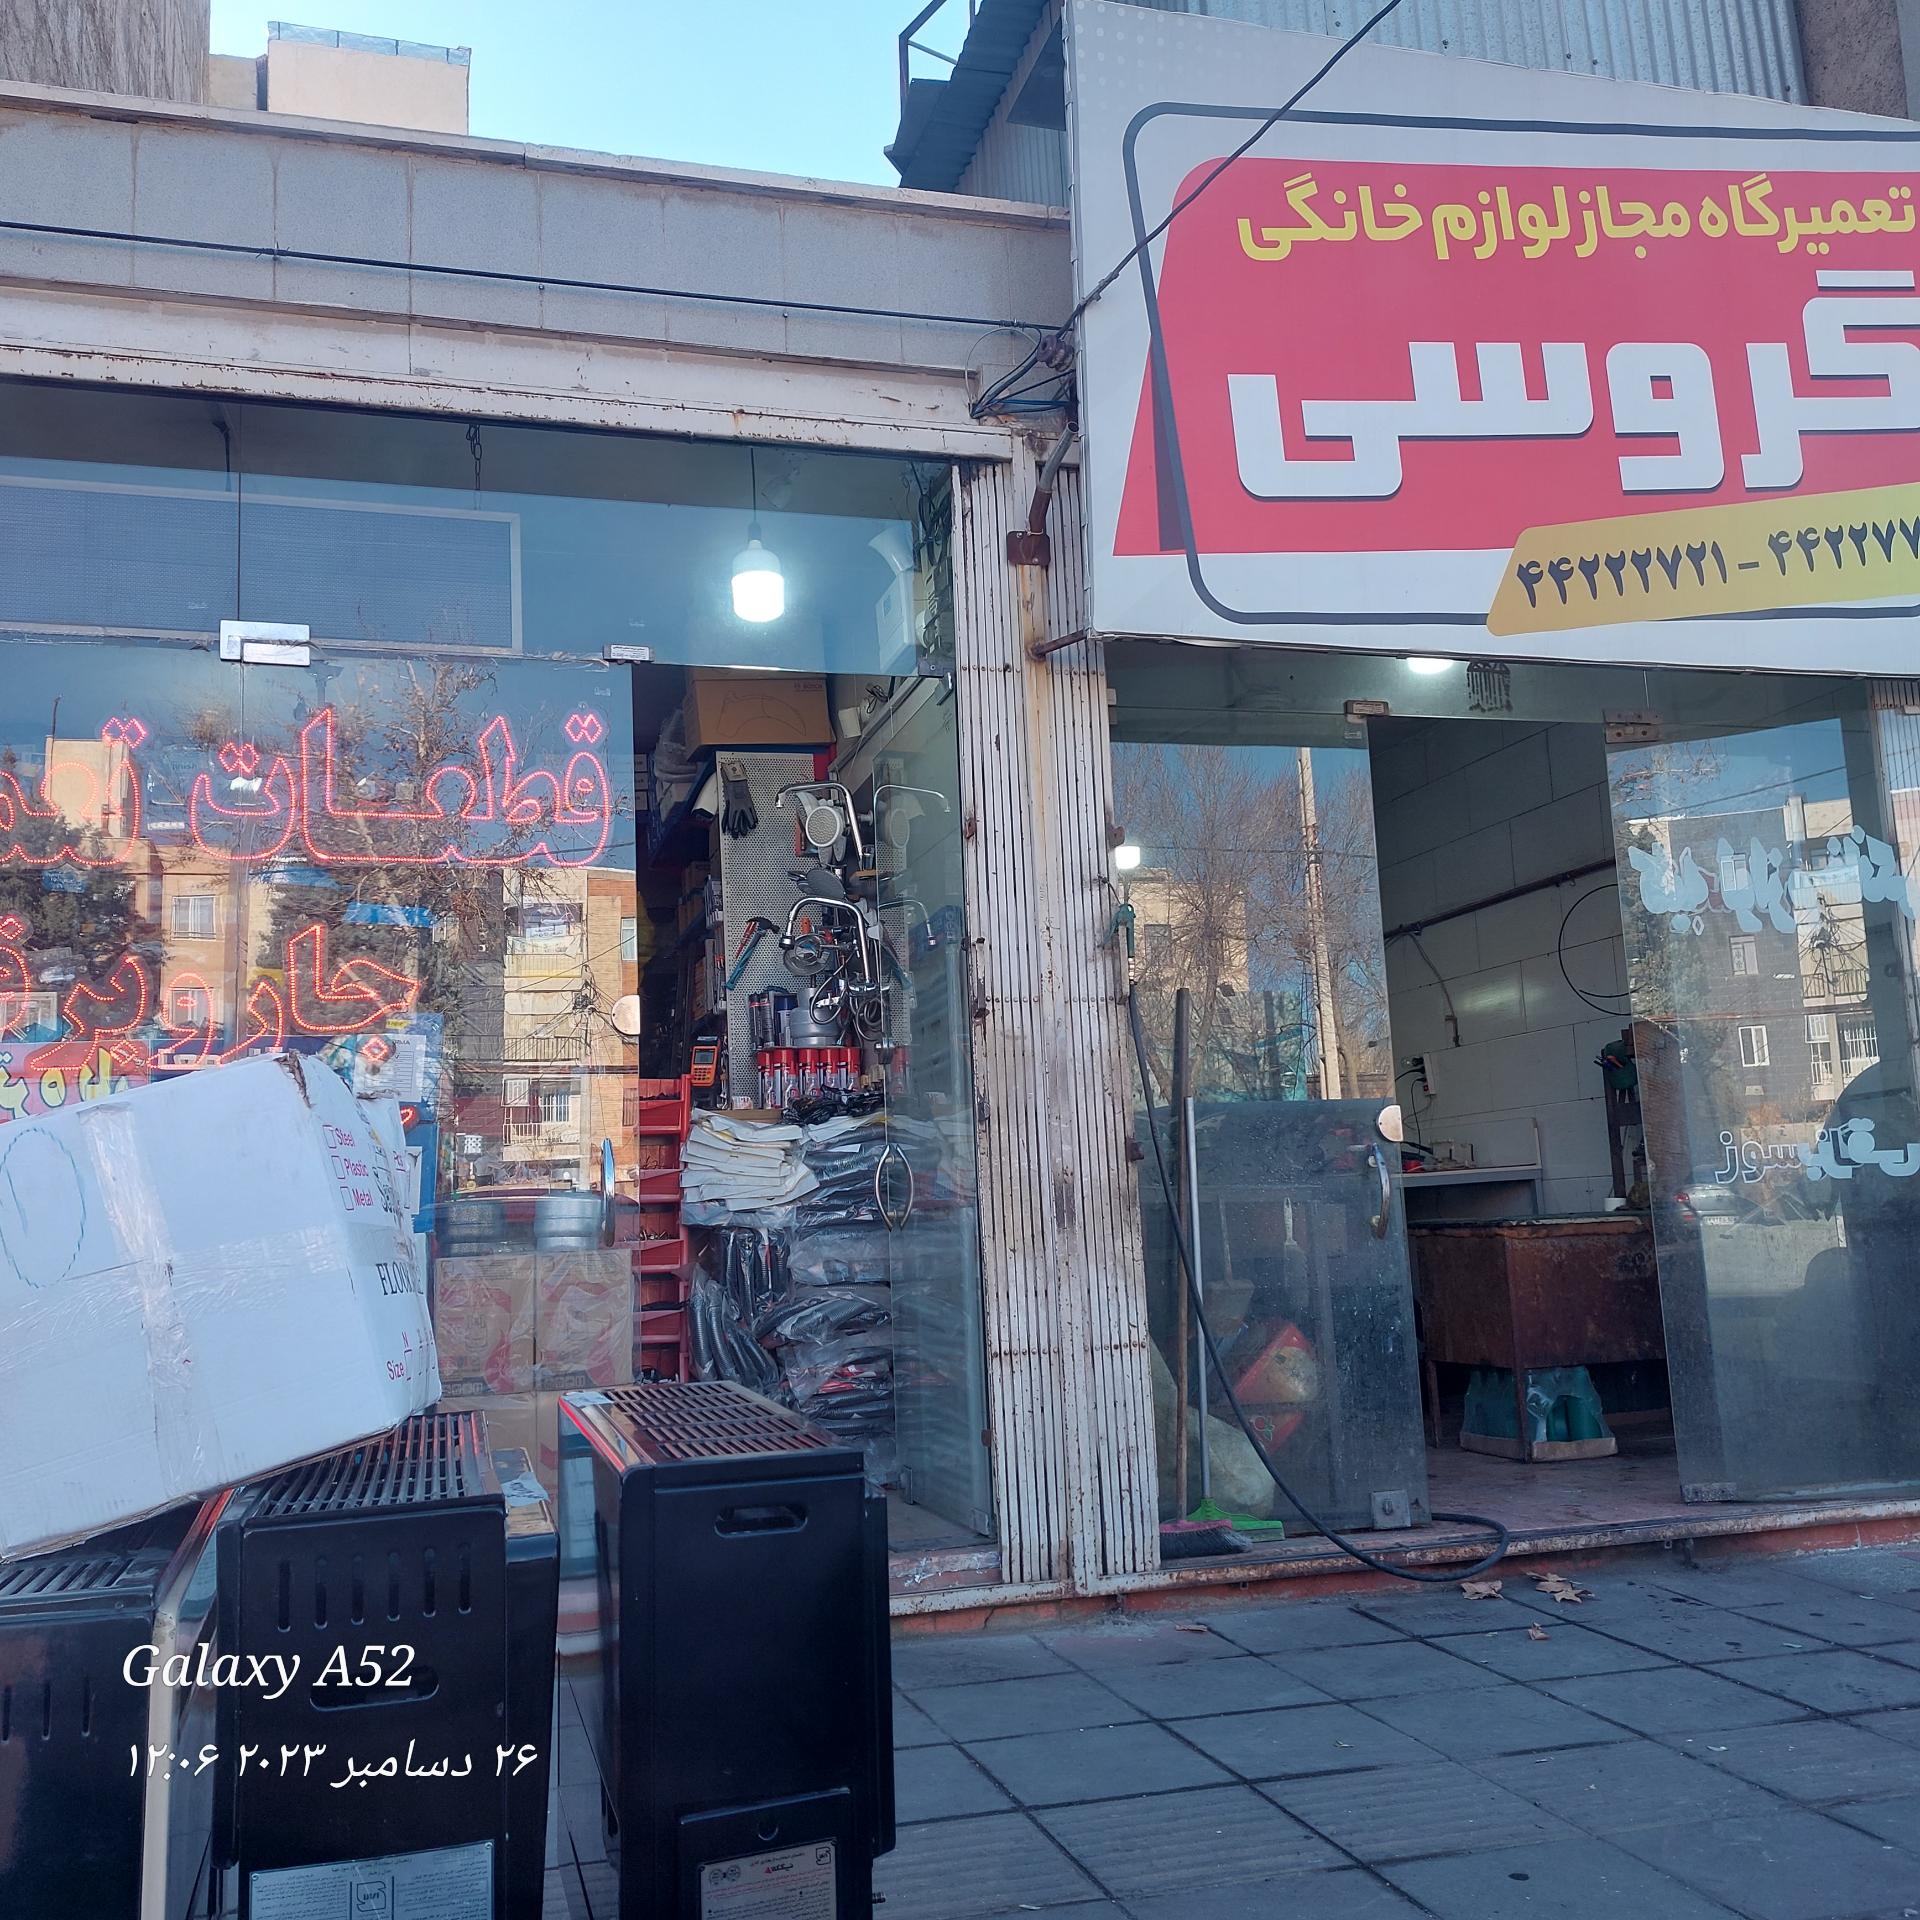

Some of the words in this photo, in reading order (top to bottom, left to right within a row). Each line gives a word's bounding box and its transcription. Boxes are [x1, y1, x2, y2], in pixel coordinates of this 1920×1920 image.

[1236, 172, 1424, 261] خانگی
[1431, 186, 1571, 260] لوازم
[1574, 185, 1691, 259] مجاز
[1698, 172, 1917, 256] تعمیرگاه
[1227, 270, 1920, 500] گروسی
[190, 704, 611, 868] قطعات
[351, 1186, 374, 1207] Metal
[386, 1360, 405, 1380] Size
